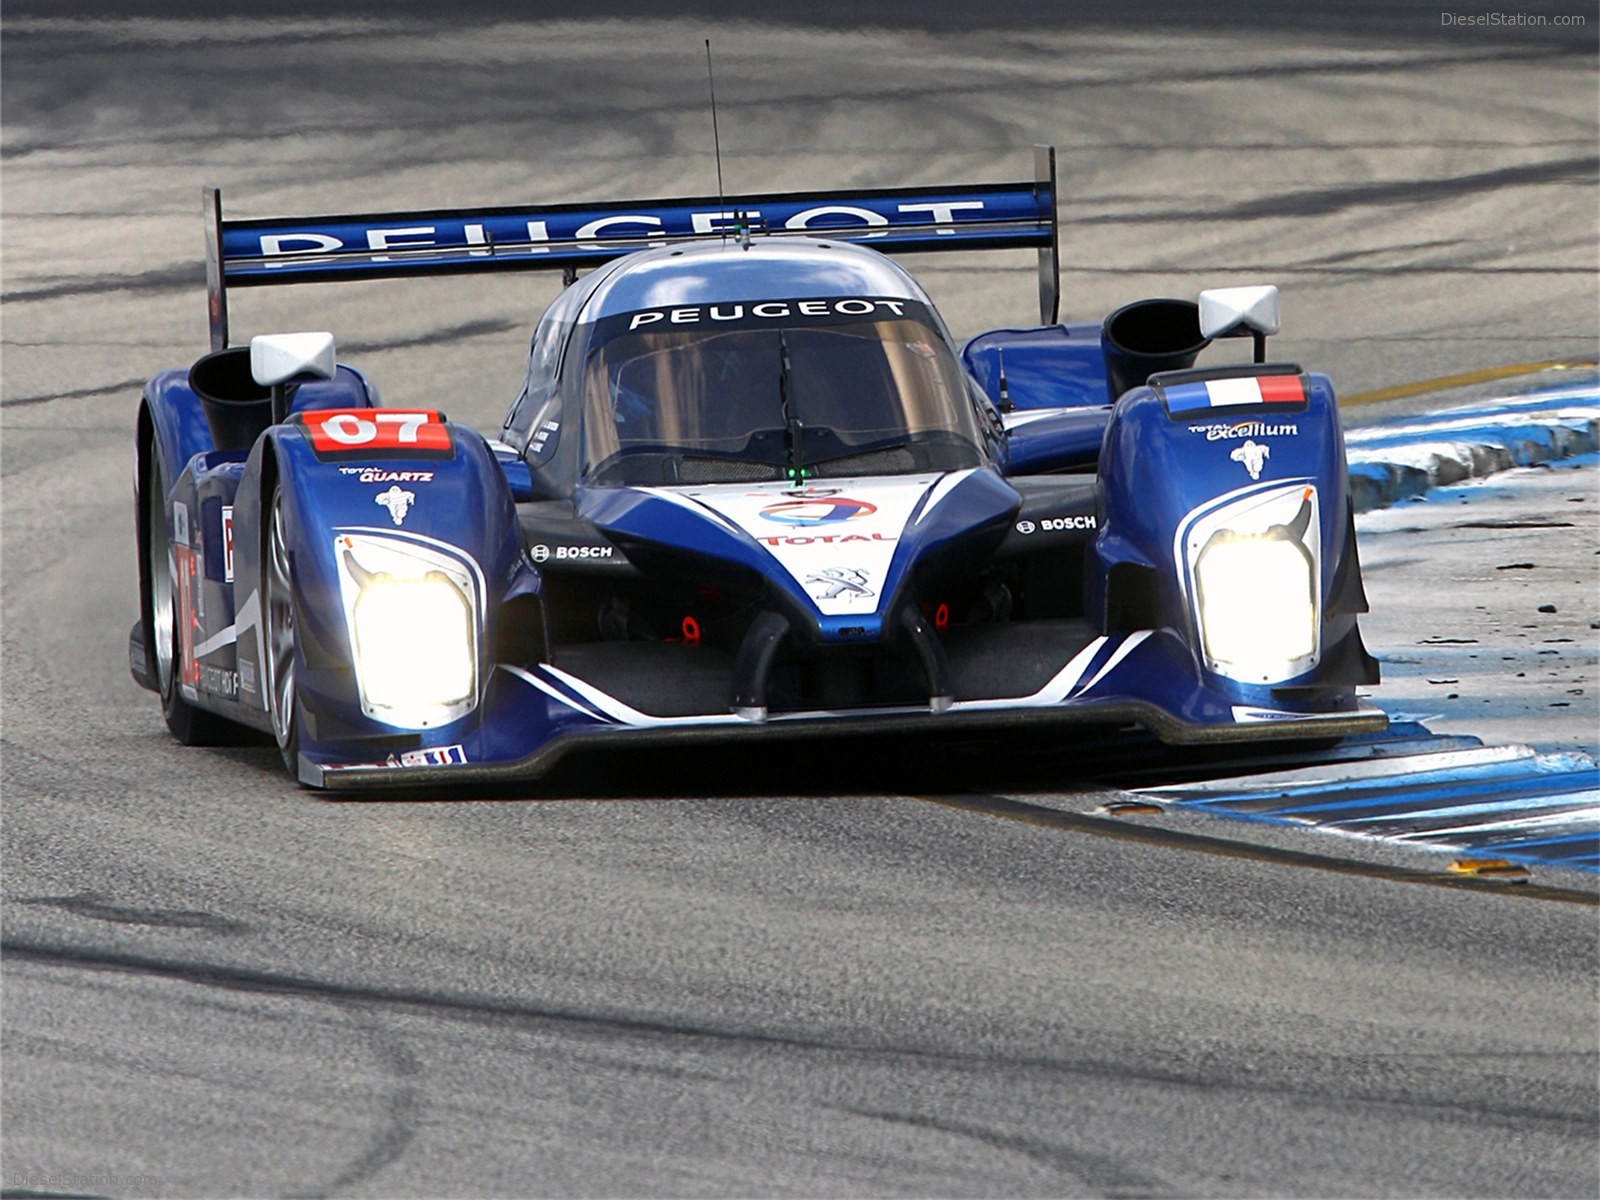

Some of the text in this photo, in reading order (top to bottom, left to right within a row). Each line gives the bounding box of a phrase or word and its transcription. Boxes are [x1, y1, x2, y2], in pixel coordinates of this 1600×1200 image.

[260, 201, 984, 269] PEUGEOT
[629, 300, 905, 330] PEUGEOT
[320, 414, 429, 444] 07
[1188, 423, 1231, 433] TOTAL
[338, 466, 383, 475] TOTAL
[359, 472, 434, 482] QUARTZ
[1040, 516, 1097, 531] BOSCH
[756, 533, 898, 546] TOTAL
[556, 546, 613, 559] BOSCH
